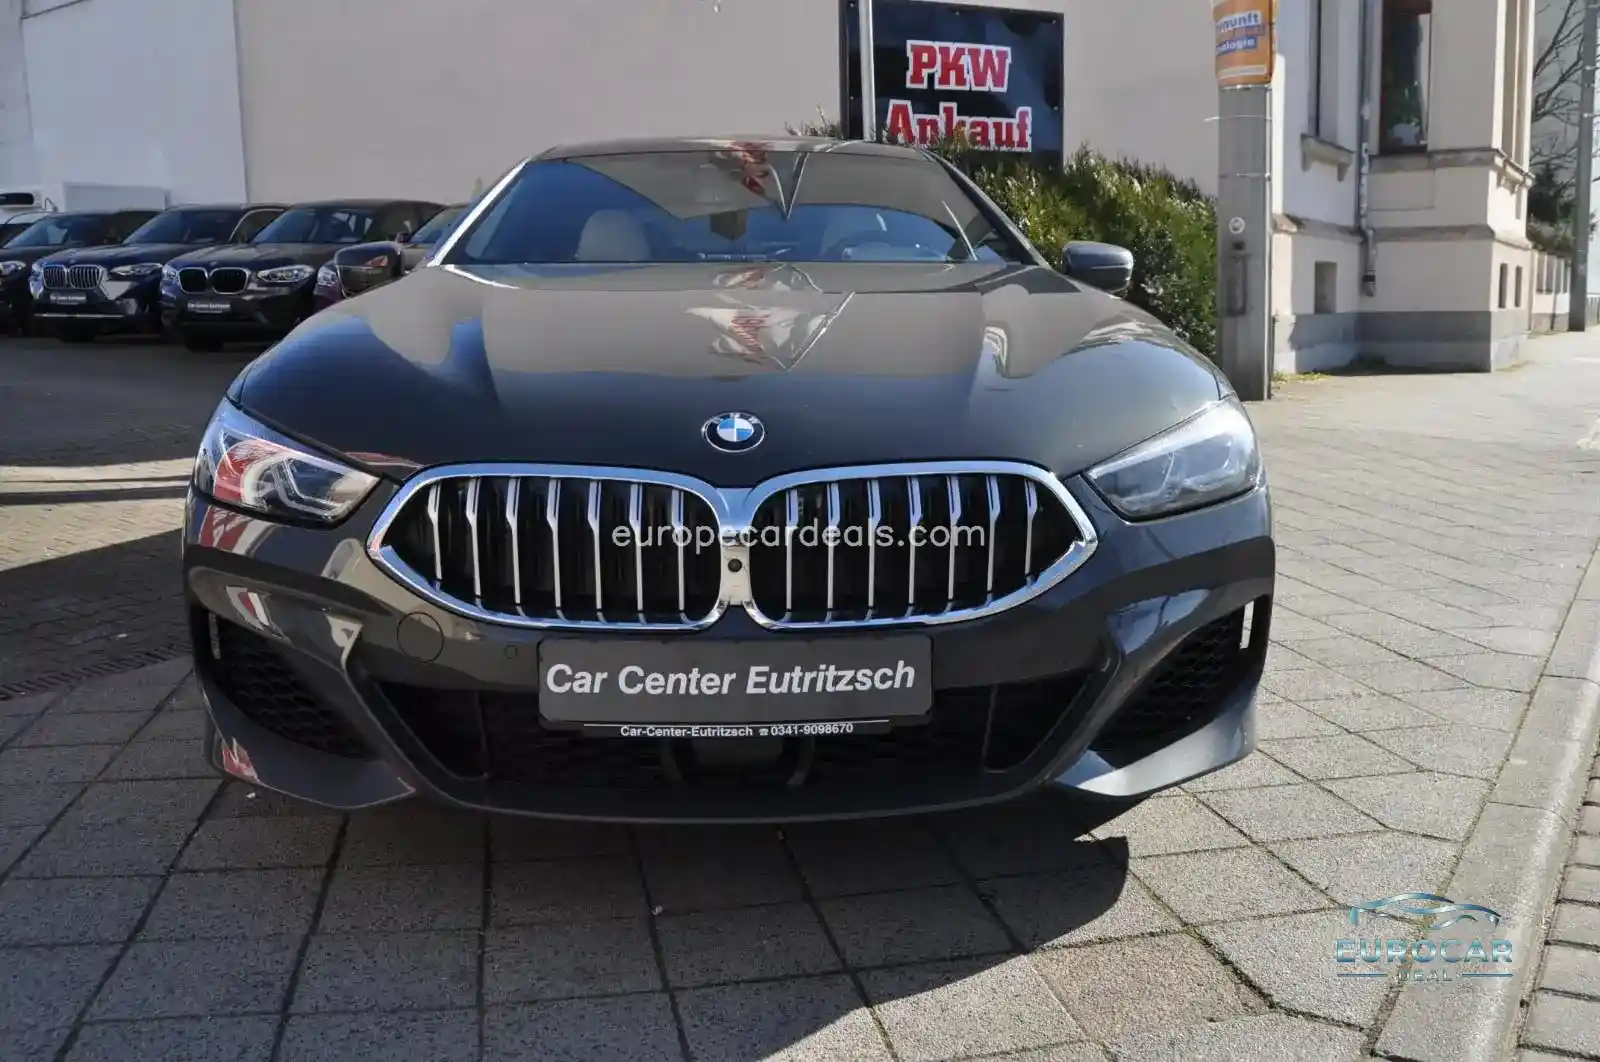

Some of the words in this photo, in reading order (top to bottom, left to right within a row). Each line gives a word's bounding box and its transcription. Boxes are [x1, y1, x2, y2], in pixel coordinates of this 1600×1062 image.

[906, 40, 1011, 93] PKW
[884, 99, 1032, 152] Ankauf
[546, 663, 608, 694] Car
[618, 665, 735, 696] Center
[745, 659, 916, 695] Eutritzsch
[620, 725, 753, 737] Car-Center-Eutritzsch
